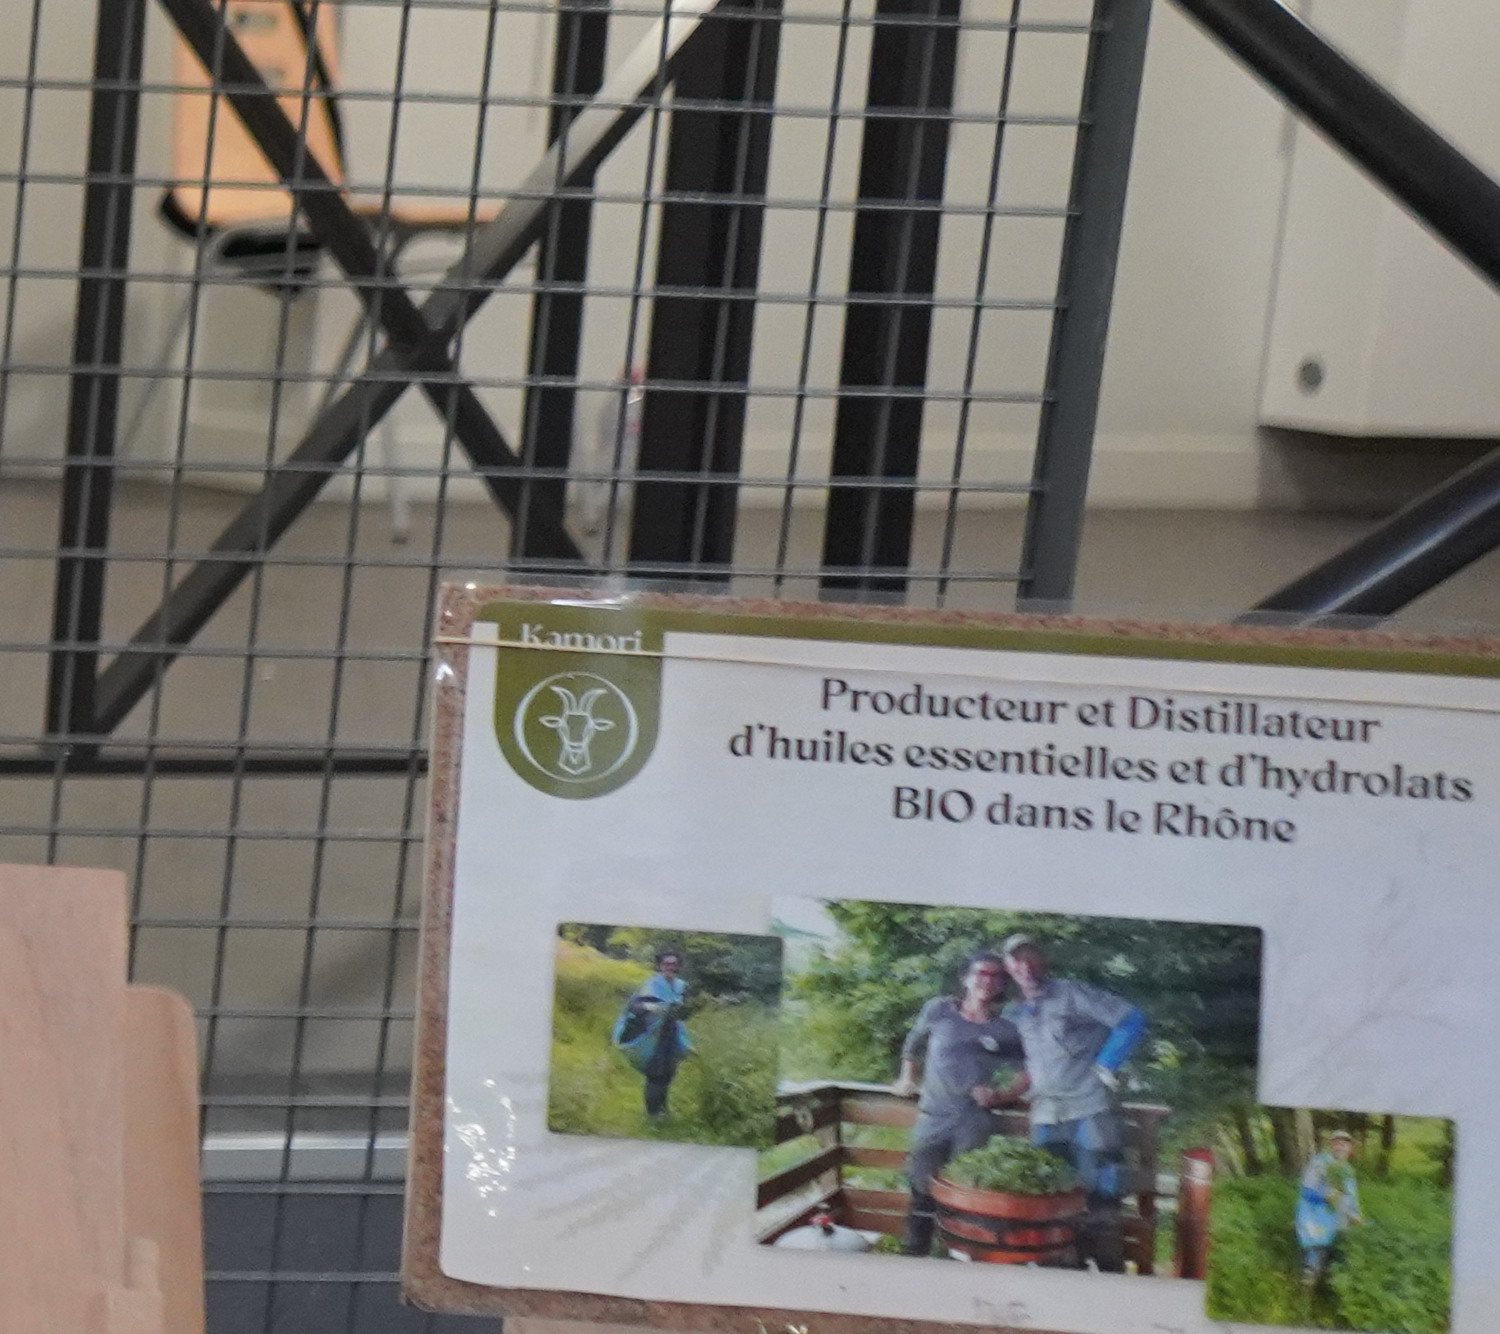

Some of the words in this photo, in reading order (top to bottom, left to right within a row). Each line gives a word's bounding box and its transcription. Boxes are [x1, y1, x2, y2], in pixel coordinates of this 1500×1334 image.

[520, 622, 643, 654] Kamori
[821, 676, 1063, 725] Producteur
[1077, 694, 1117, 728] et
[1128, 694, 1383, 745] Distillateur
[728, 722, 893, 771] d'huiles
[904, 740, 1158, 785] essentielles
[1170, 753, 1209, 787] et
[1219, 751, 1474, 803] d'hydrolats
[893, 784, 973, 825] BIO
[985, 791, 1095, 833] dans
[1105, 798, 1141, 836] le
[1153, 801, 1295, 844] Rhône
